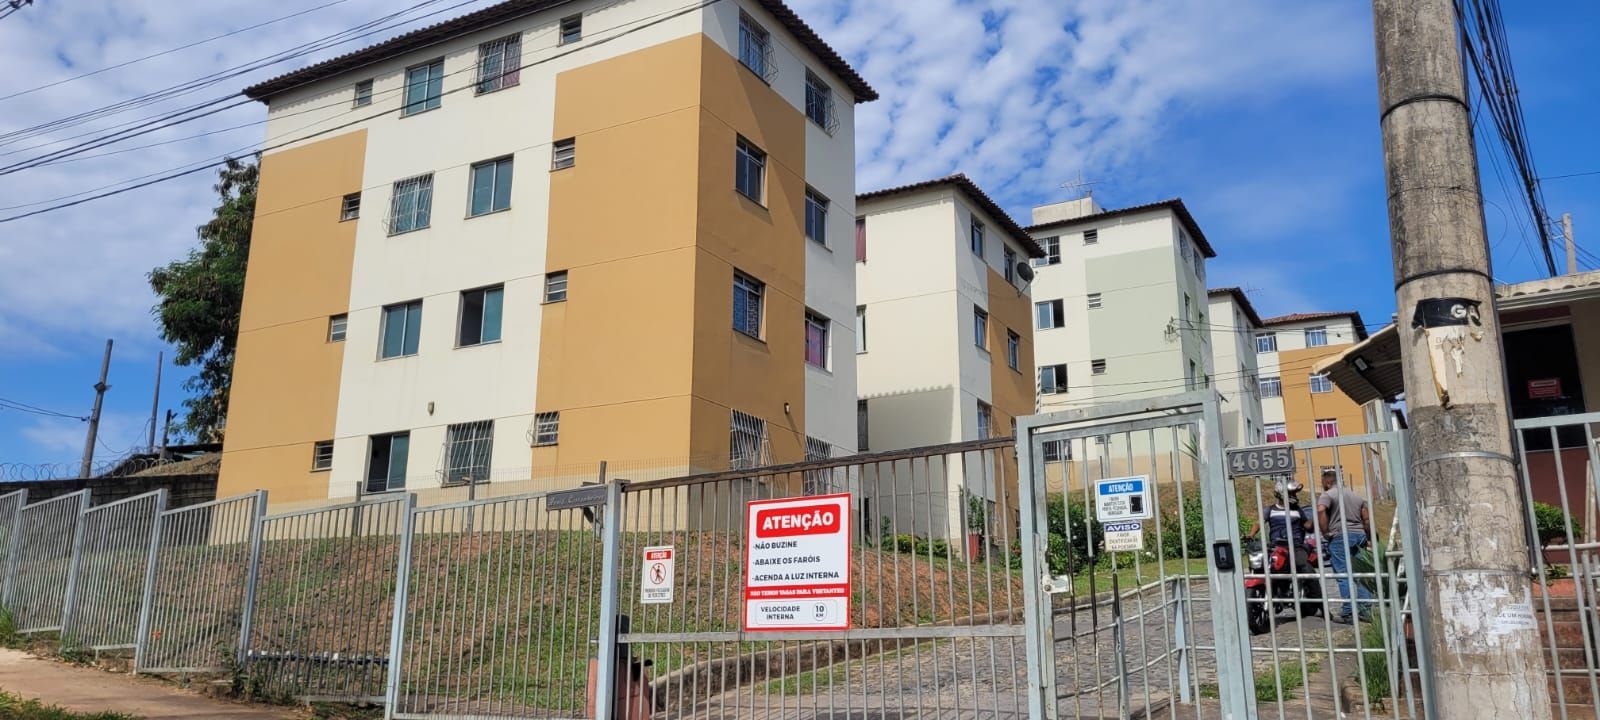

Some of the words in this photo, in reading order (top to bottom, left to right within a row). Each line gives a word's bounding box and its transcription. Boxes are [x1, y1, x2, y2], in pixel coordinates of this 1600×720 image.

[1232, 449, 1289, 472] 4655
[1108, 482, 1134, 493] ATENÇÃO
[762, 510, 834, 531] ATENÇÃO
[1107, 523, 1140, 531] AVISO
[771, 540, 798, 549] BUZINE
[793, 555, 821, 564] FARÓIS
[784, 573, 790, 581] A
[791, 572, 805, 580] LUZ
[805, 571, 839, 580] INTERNA
[760, 605, 801, 613] VELOCIDADE
[766, 613, 795, 621] INTERNA
